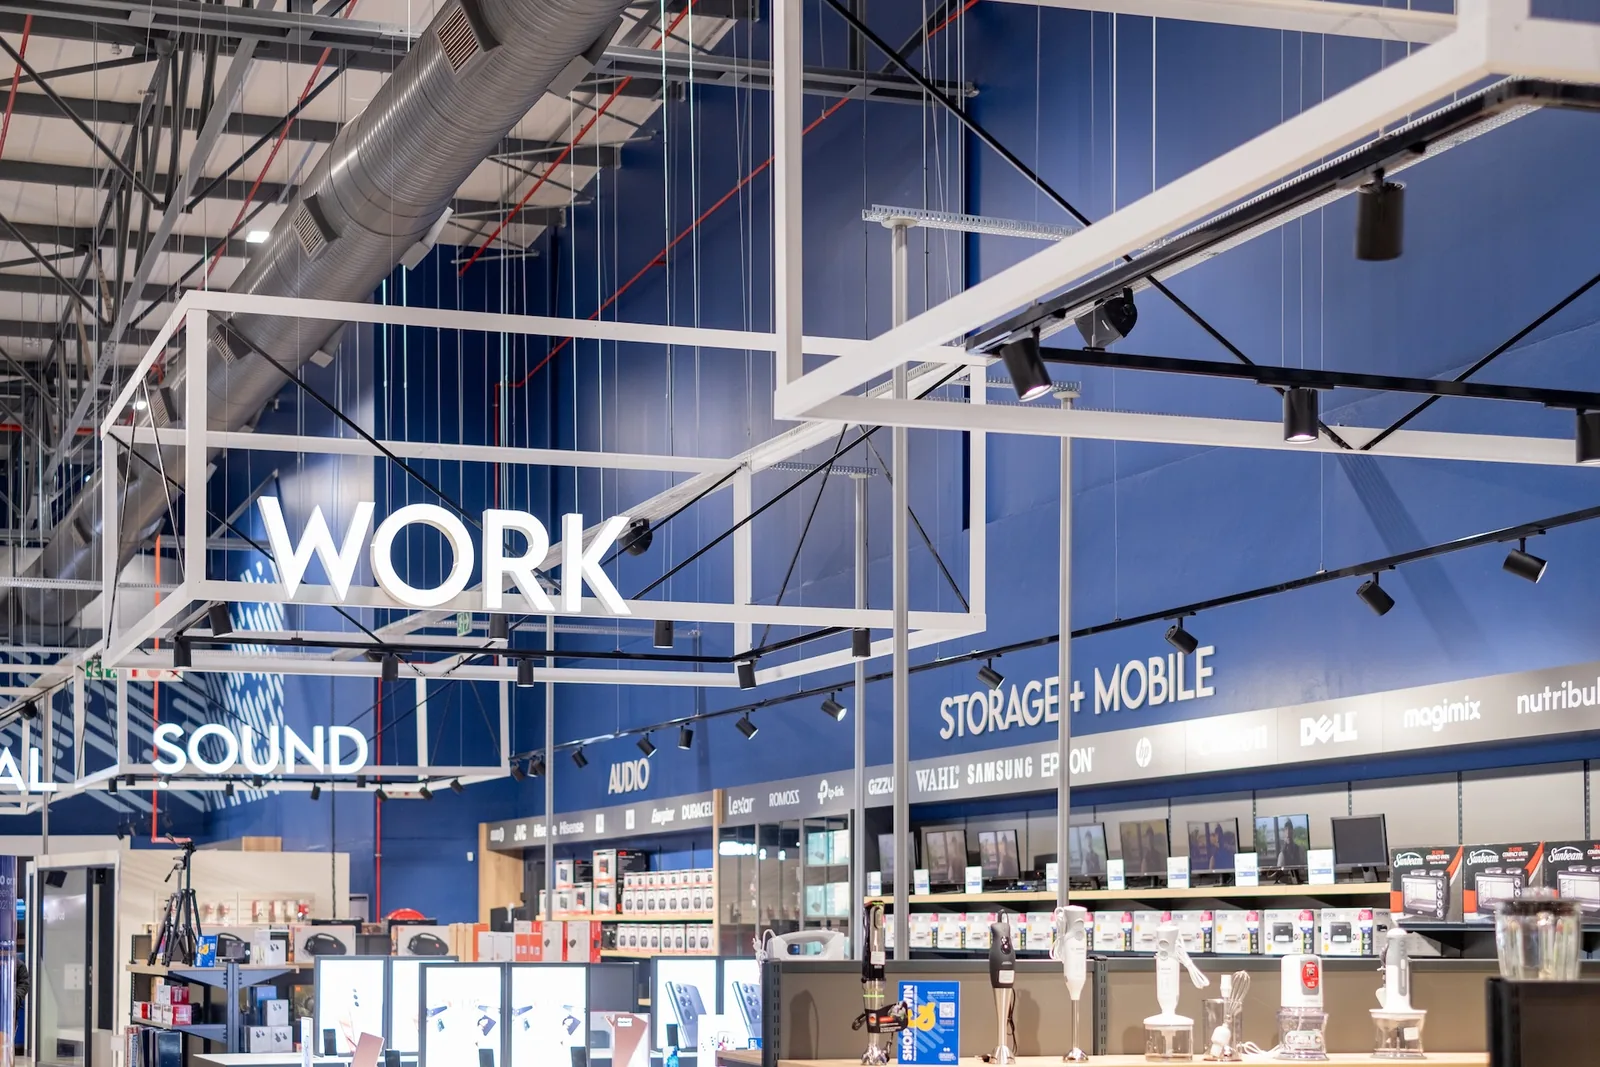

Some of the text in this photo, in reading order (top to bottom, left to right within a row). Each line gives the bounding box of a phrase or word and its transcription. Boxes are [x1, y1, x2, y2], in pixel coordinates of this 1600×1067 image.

[257, 496, 631, 615] WORK
[939, 675, 1059, 740] STORAGE
[1094, 644, 1215, 715] MOBILE
[1300, 711, 1358, 747] DELL
[1403, 695, 1481, 732] magimix
[152, 722, 369, 775] SOUND
[1040, 747, 1093, 778] EPON
[607, 757, 650, 796] AUDIO
[967, 757, 1032, 785] SAMSUNG
[728, 796, 755, 816] Lexar
[1393, 853, 1424, 868] Sunbeam
[1466, 850, 1499, 866] Sunbeam
[1548, 847, 1584, 864] Sunbeam
[902, 1028, 914, 1061] SHOP
